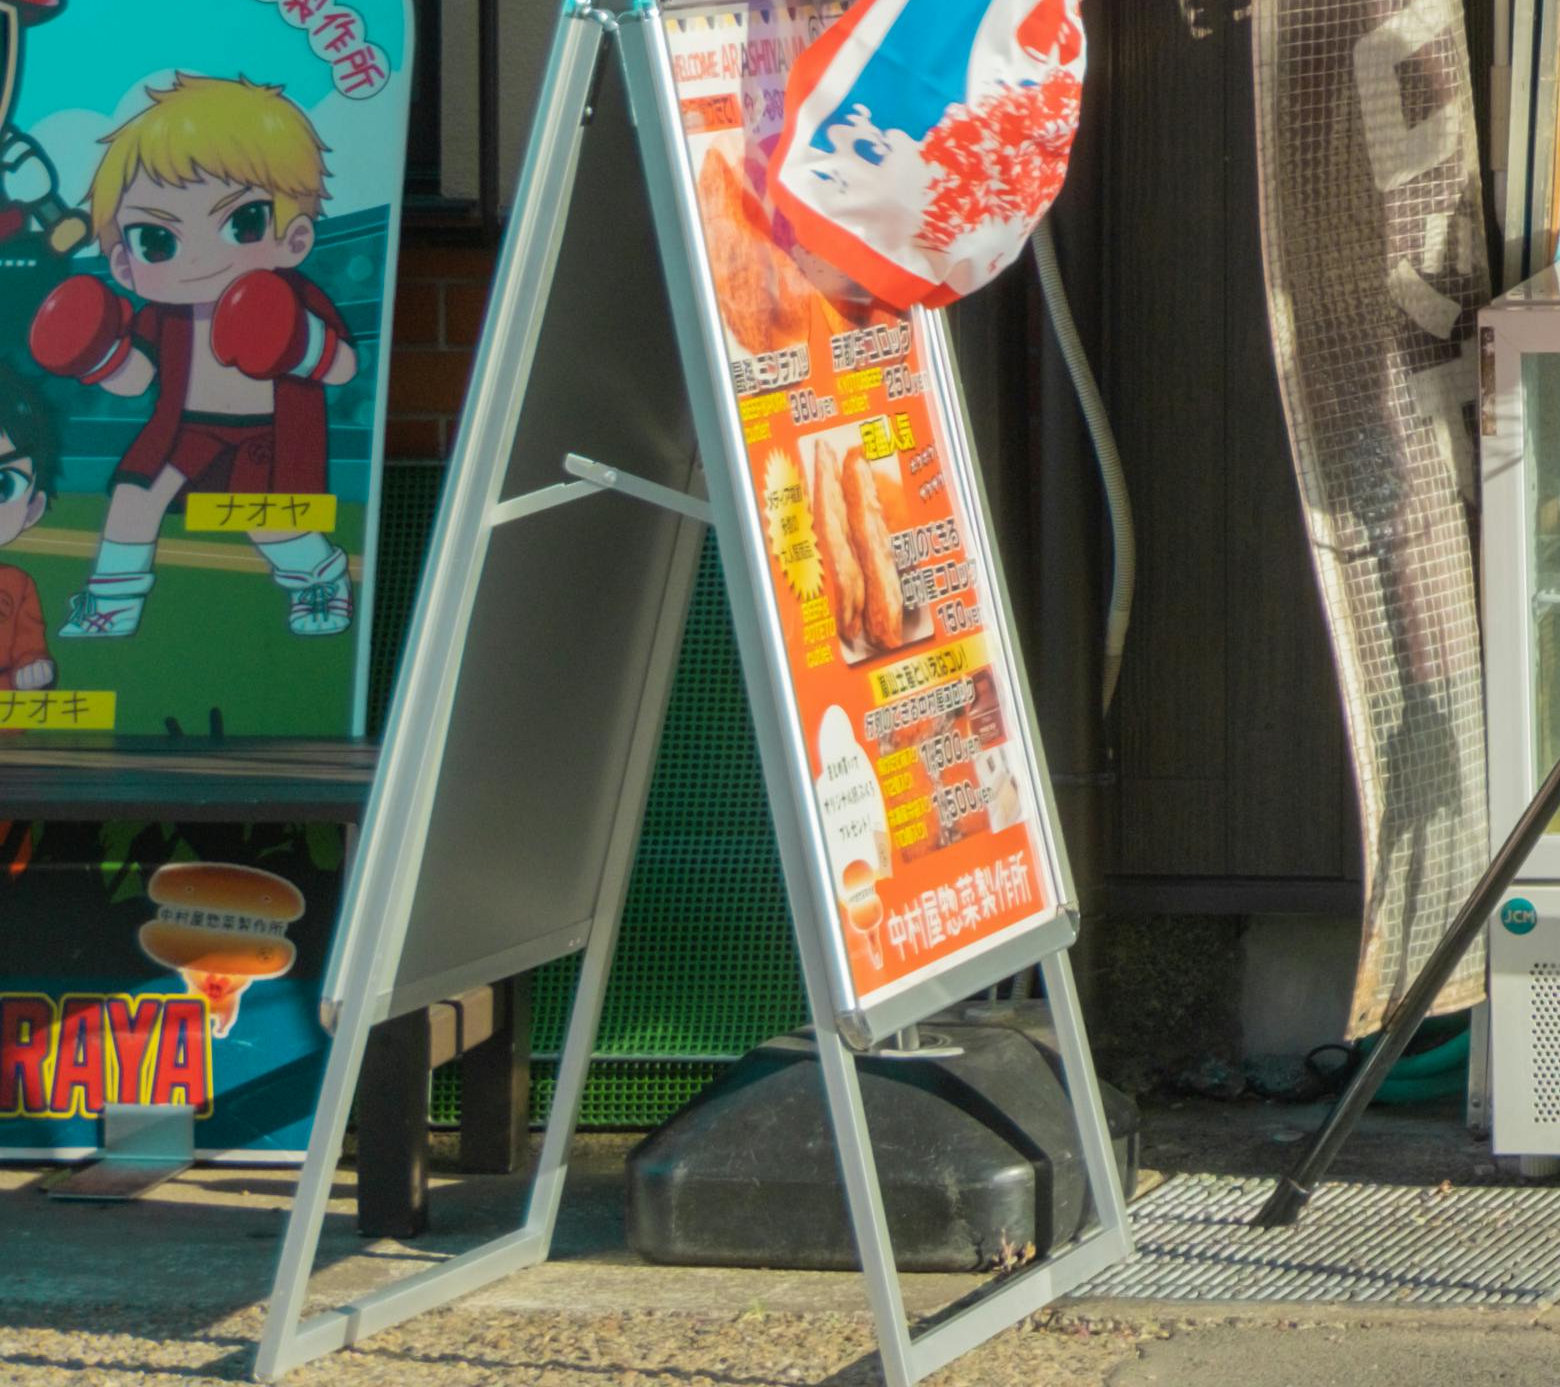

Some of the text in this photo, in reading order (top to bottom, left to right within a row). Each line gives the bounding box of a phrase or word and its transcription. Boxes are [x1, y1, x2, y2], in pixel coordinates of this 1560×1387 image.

[215, 496, 311, 527] ナオヤ
[887, 849, 1033, 962] 中村屋惣菜製作所
[1501, 907, 1536, 925] JCM
